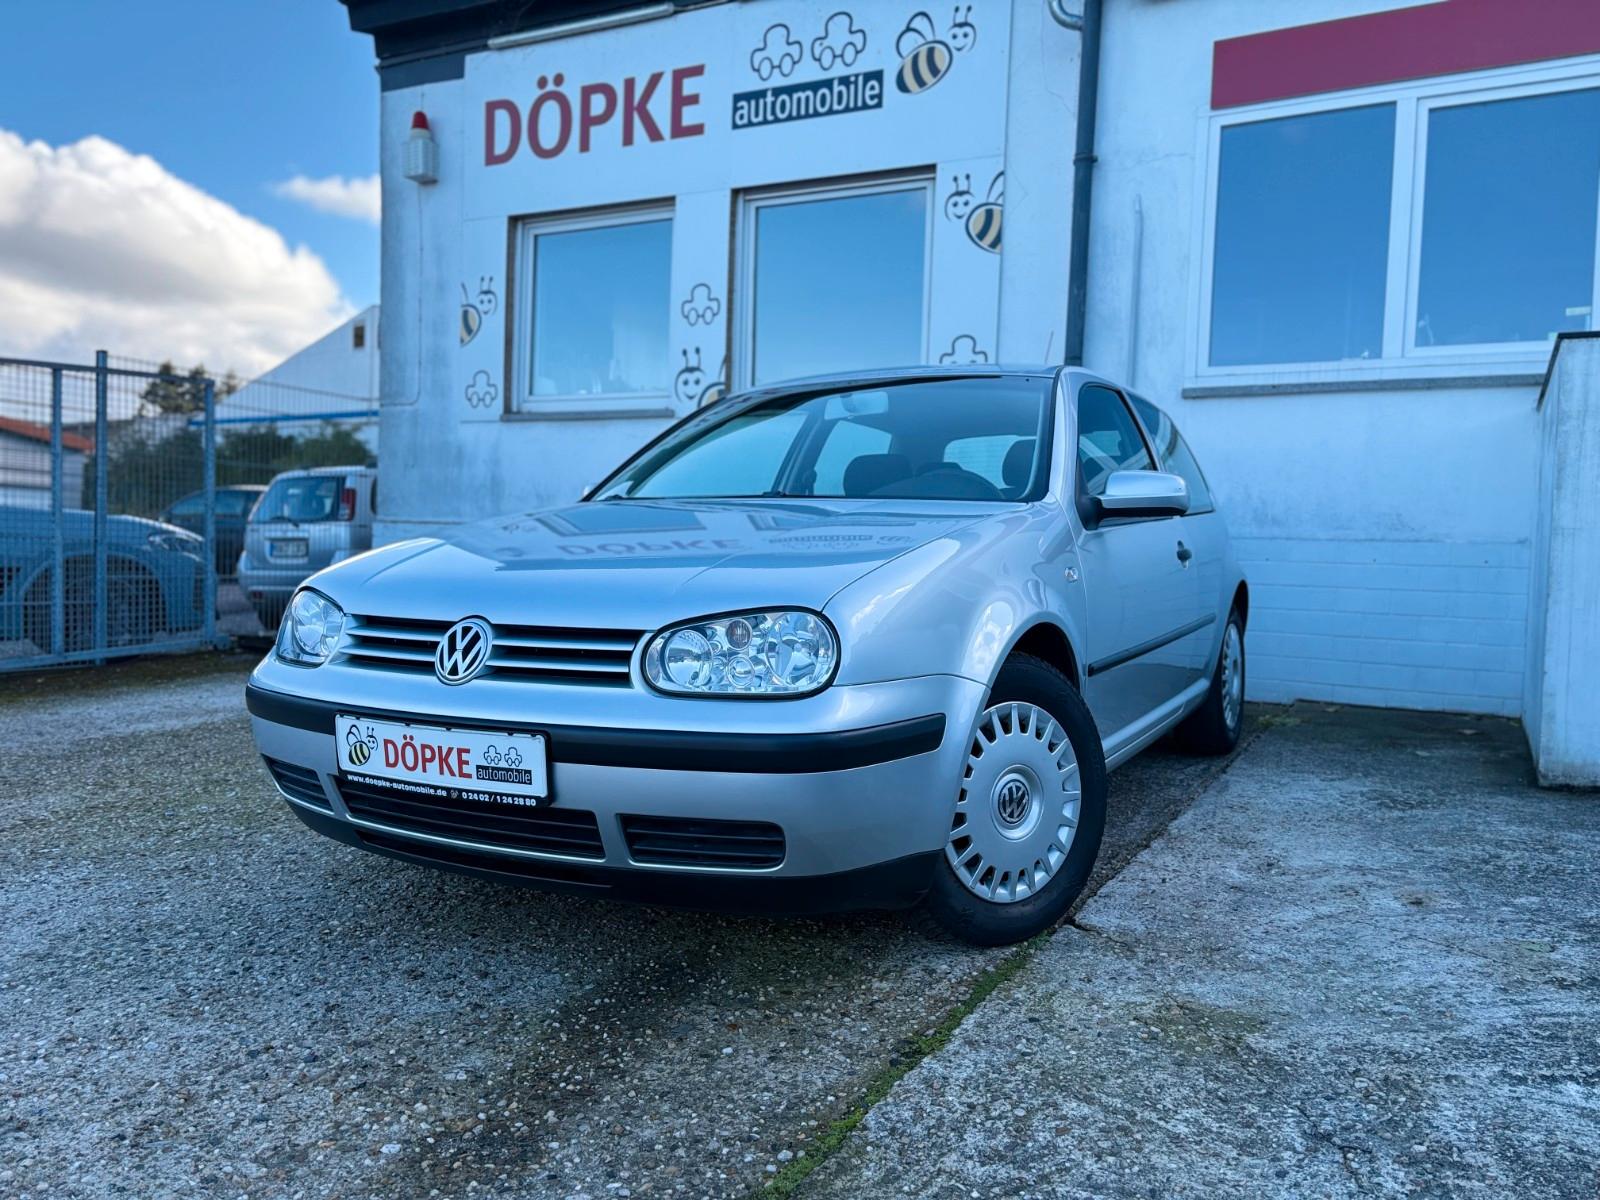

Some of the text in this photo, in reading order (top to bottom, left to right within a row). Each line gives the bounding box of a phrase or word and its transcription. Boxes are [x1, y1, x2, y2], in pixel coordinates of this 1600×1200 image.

[484, 63, 706, 166] DÖPKE
[734, 74, 881, 128] automobile
[383, 734, 473, 779] DÖPKE
[477, 766, 531, 784] automobile
